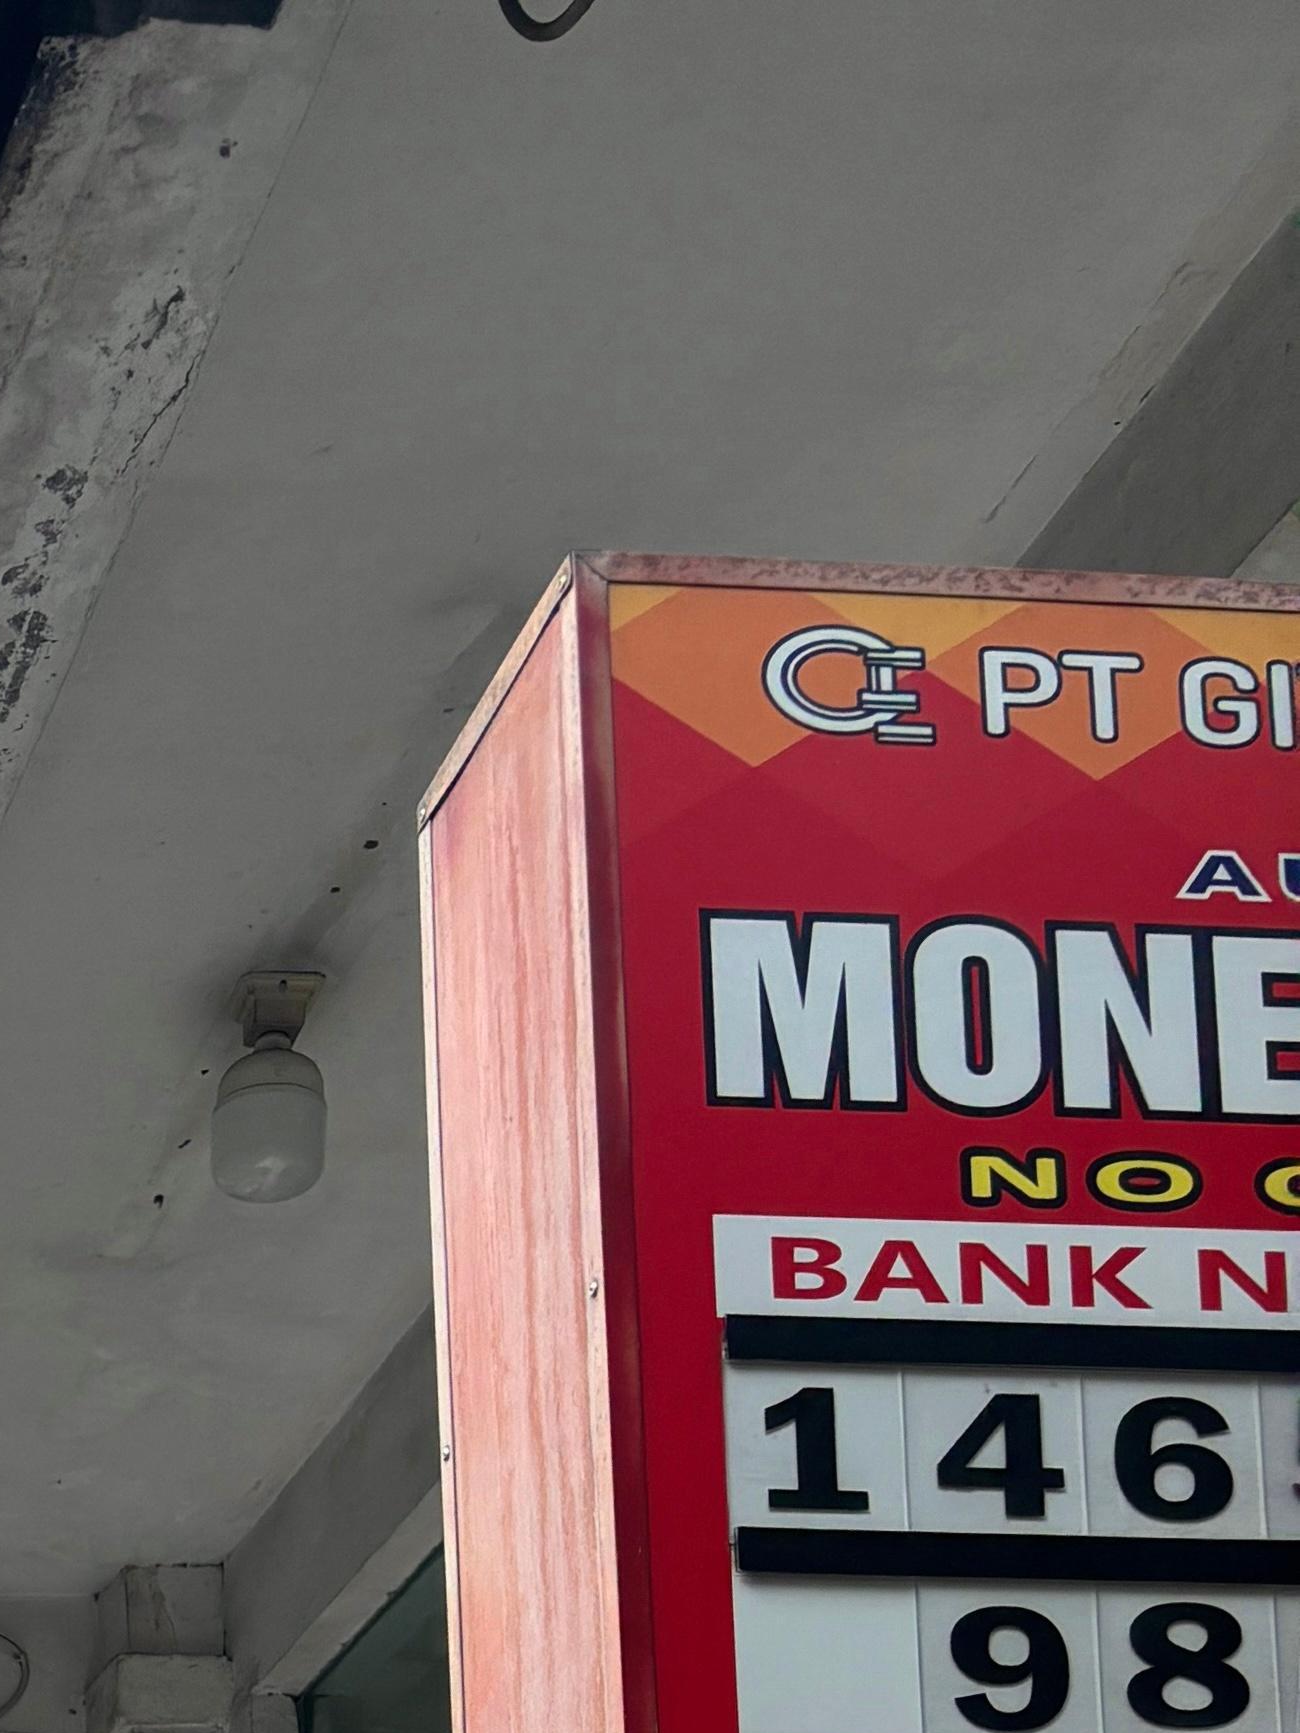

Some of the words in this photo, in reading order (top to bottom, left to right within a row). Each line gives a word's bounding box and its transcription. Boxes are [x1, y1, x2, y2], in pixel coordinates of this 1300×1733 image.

[979, 645, 1143, 743] PT
[1178, 656, 1300, 751] GI
[699, 908, 1300, 1123] MONE
[961, 1146, 1202, 1210] NO
[769, 1236, 1151, 1312] BANK
[1198, 1250, 1288, 1313] N
[764, 1387, 1300, 1522] 146
[950, 1602, 1251, 1733] 98
